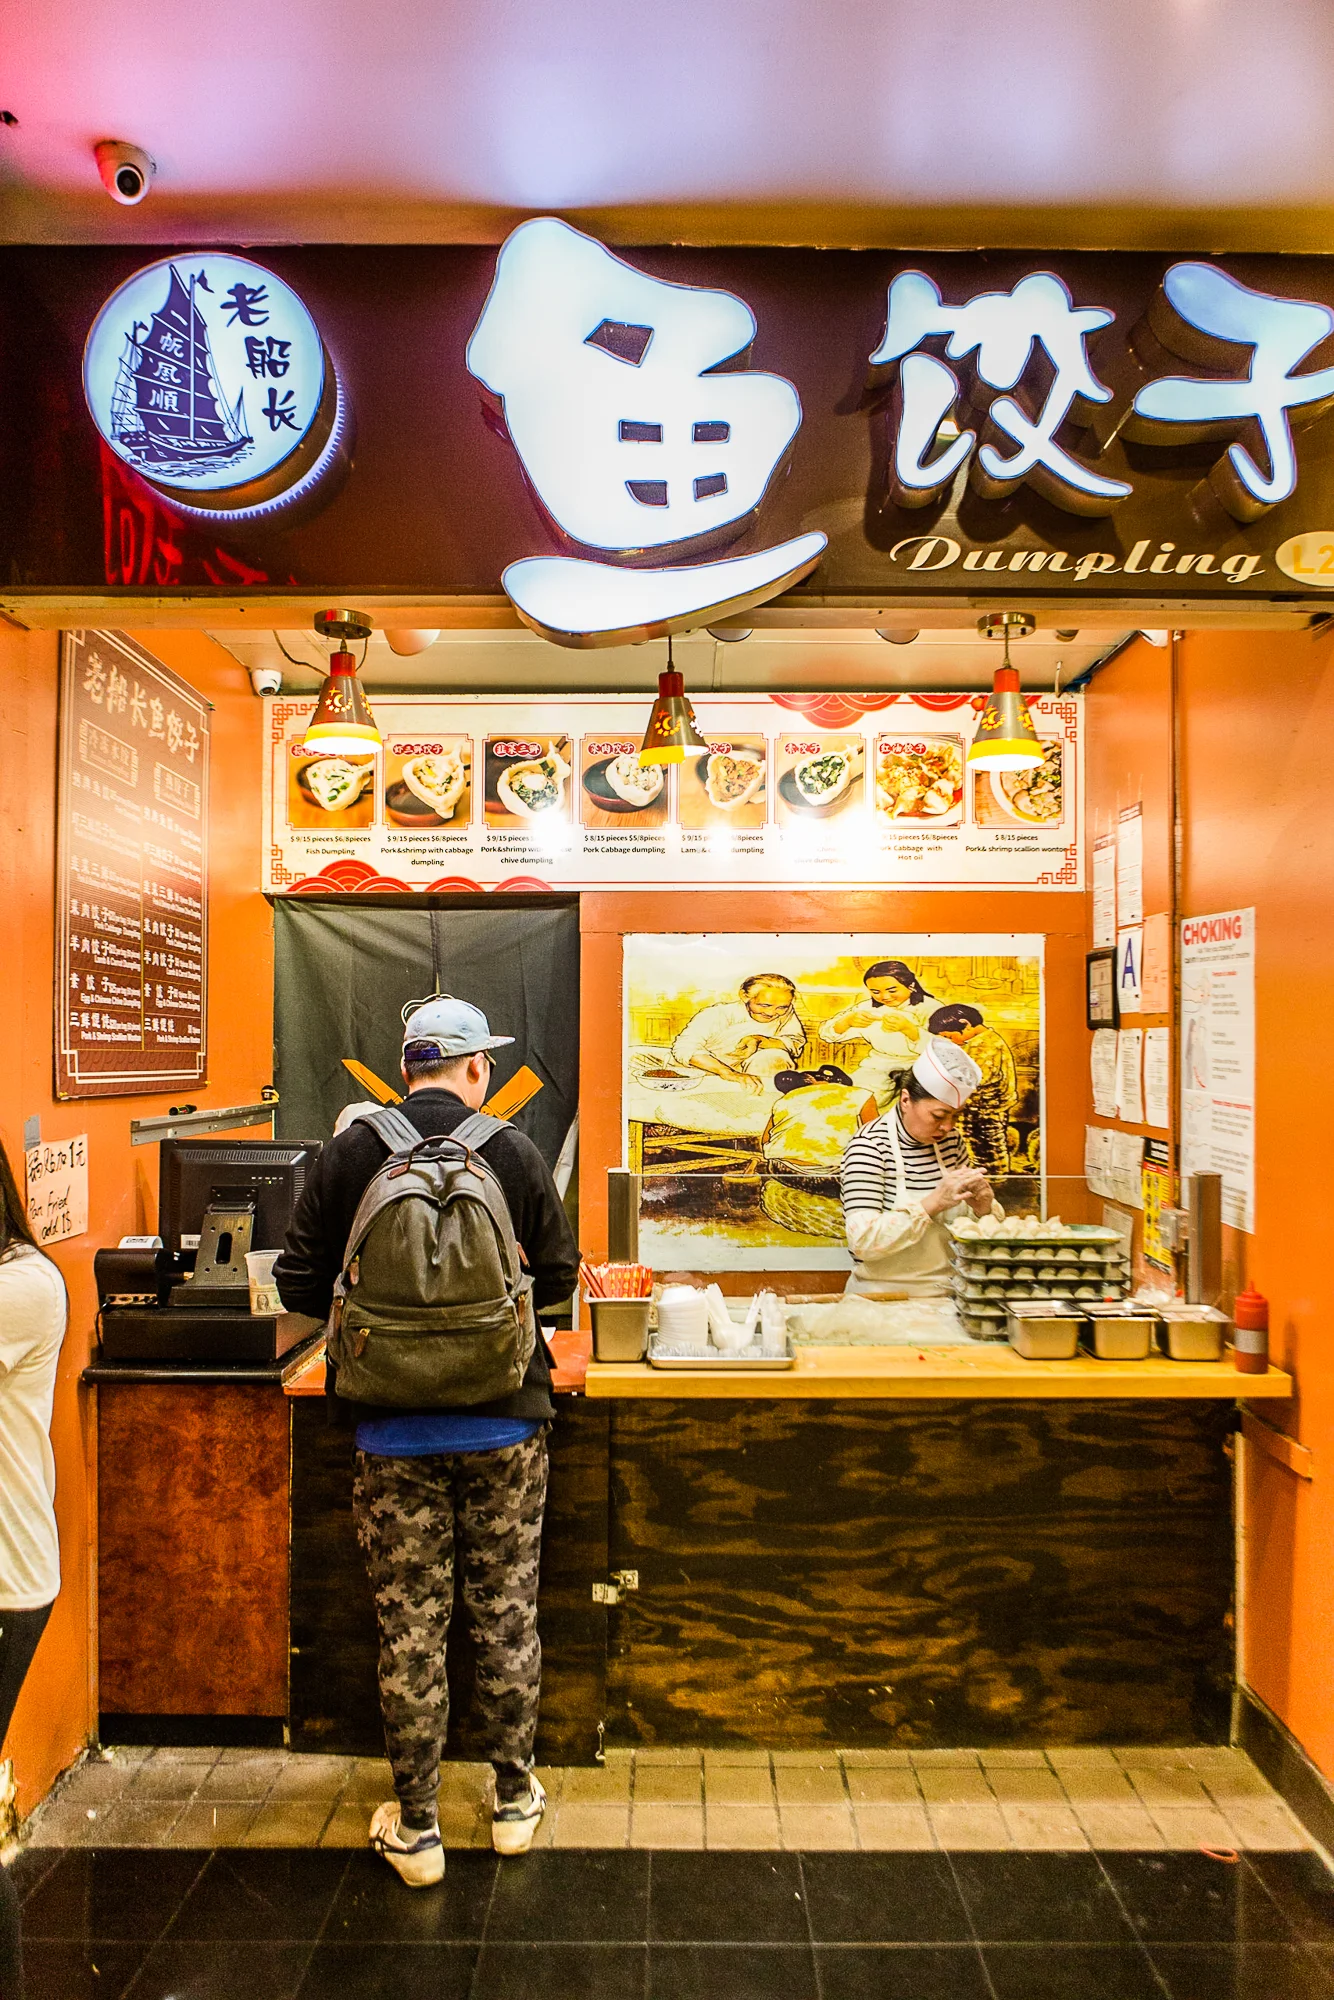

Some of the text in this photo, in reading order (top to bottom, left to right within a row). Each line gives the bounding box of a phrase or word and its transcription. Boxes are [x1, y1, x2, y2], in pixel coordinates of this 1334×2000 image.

[220, 282, 303, 432] 老船长
[465, 217, 1334, 634] 鱼饺子
[889, 535, 1267, 584] Dumpling
[312, 836, 334, 844] pieces
[409, 836, 431, 844] pieces
[606, 835, 628, 843] pieces
[322, 848, 355, 856] Dumpling
[445, 847, 474, 855] cabbage
[601, 847, 631, 855] Cabbage
[632, 846, 666, 854] dumpling
[893, 845, 924, 853] Cabbage
[411, 858, 445, 867] dumpling
[520, 857, 553, 865] dumpling
[1183, 915, 1242, 946] CHOKING
[1122, 938, 1137, 988] A
